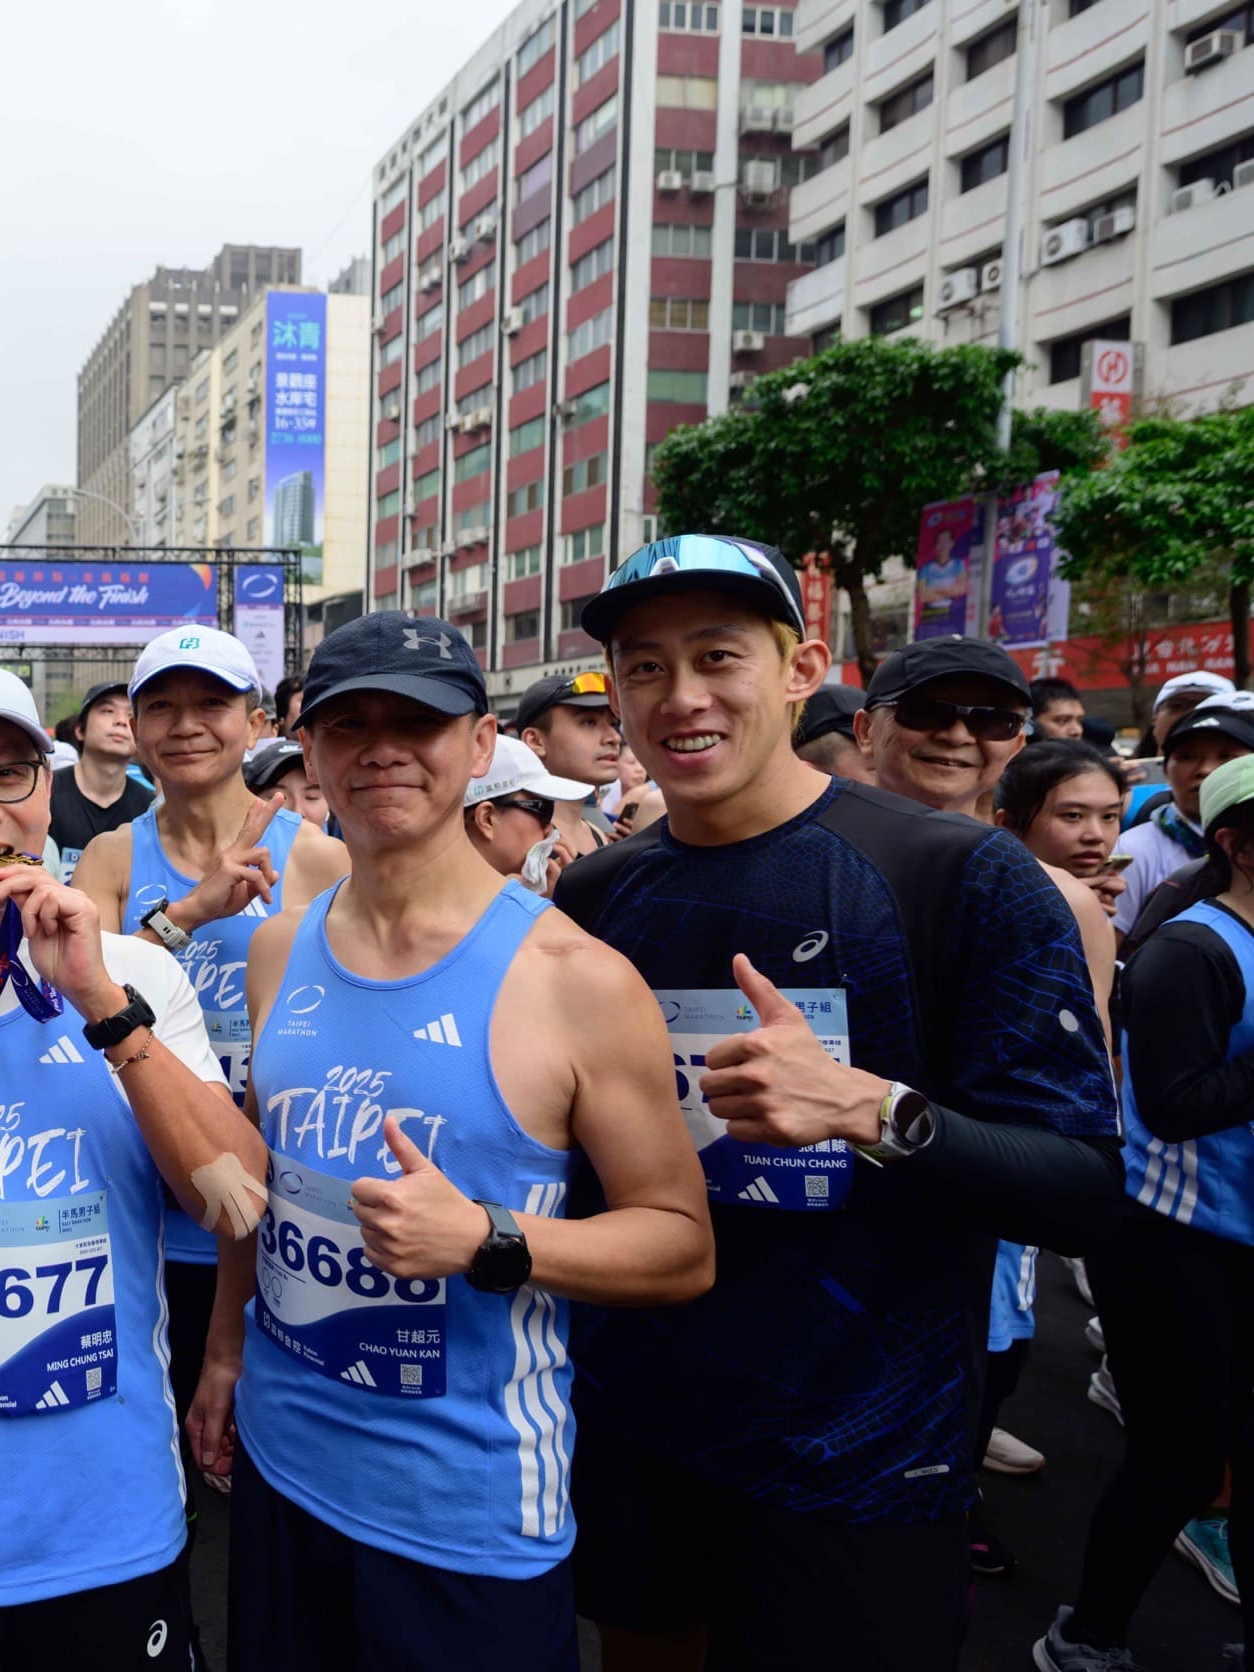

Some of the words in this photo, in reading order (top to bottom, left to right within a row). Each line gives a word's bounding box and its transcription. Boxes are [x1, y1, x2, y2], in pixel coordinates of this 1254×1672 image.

[273, 321, 320, 349] 沐青
[67, 584, 96, 604] the
[98, 584, 149, 610] Finish
[277, 1028, 318, 1037] MARATHON
[287, 1020, 311, 1028] TAIPEI
[324, 1065, 392, 1097] 2025
[267, 1088, 448, 1174] TAIPEI
[743, 1155, 771, 1166] TUAN
[773, 1157, 806, 1168] CHUN
[808, 1159, 847, 1169] CHANG
[61, 1203, 101, 1220] 半馬男子組
[80, 1330, 113, 1349] 蔡明忠
[396, 1329, 441, 1344] 甘超元
[359, 1342, 387, 1356] CHAO
[389, 1347, 417, 1359] YUAN
[419, 1349, 441, 1359] KAN
[47, 1360, 69, 1372] MING
[70, 1353, 98, 1368] CHUNG
[98, 1348, 114, 1360] TSAI
